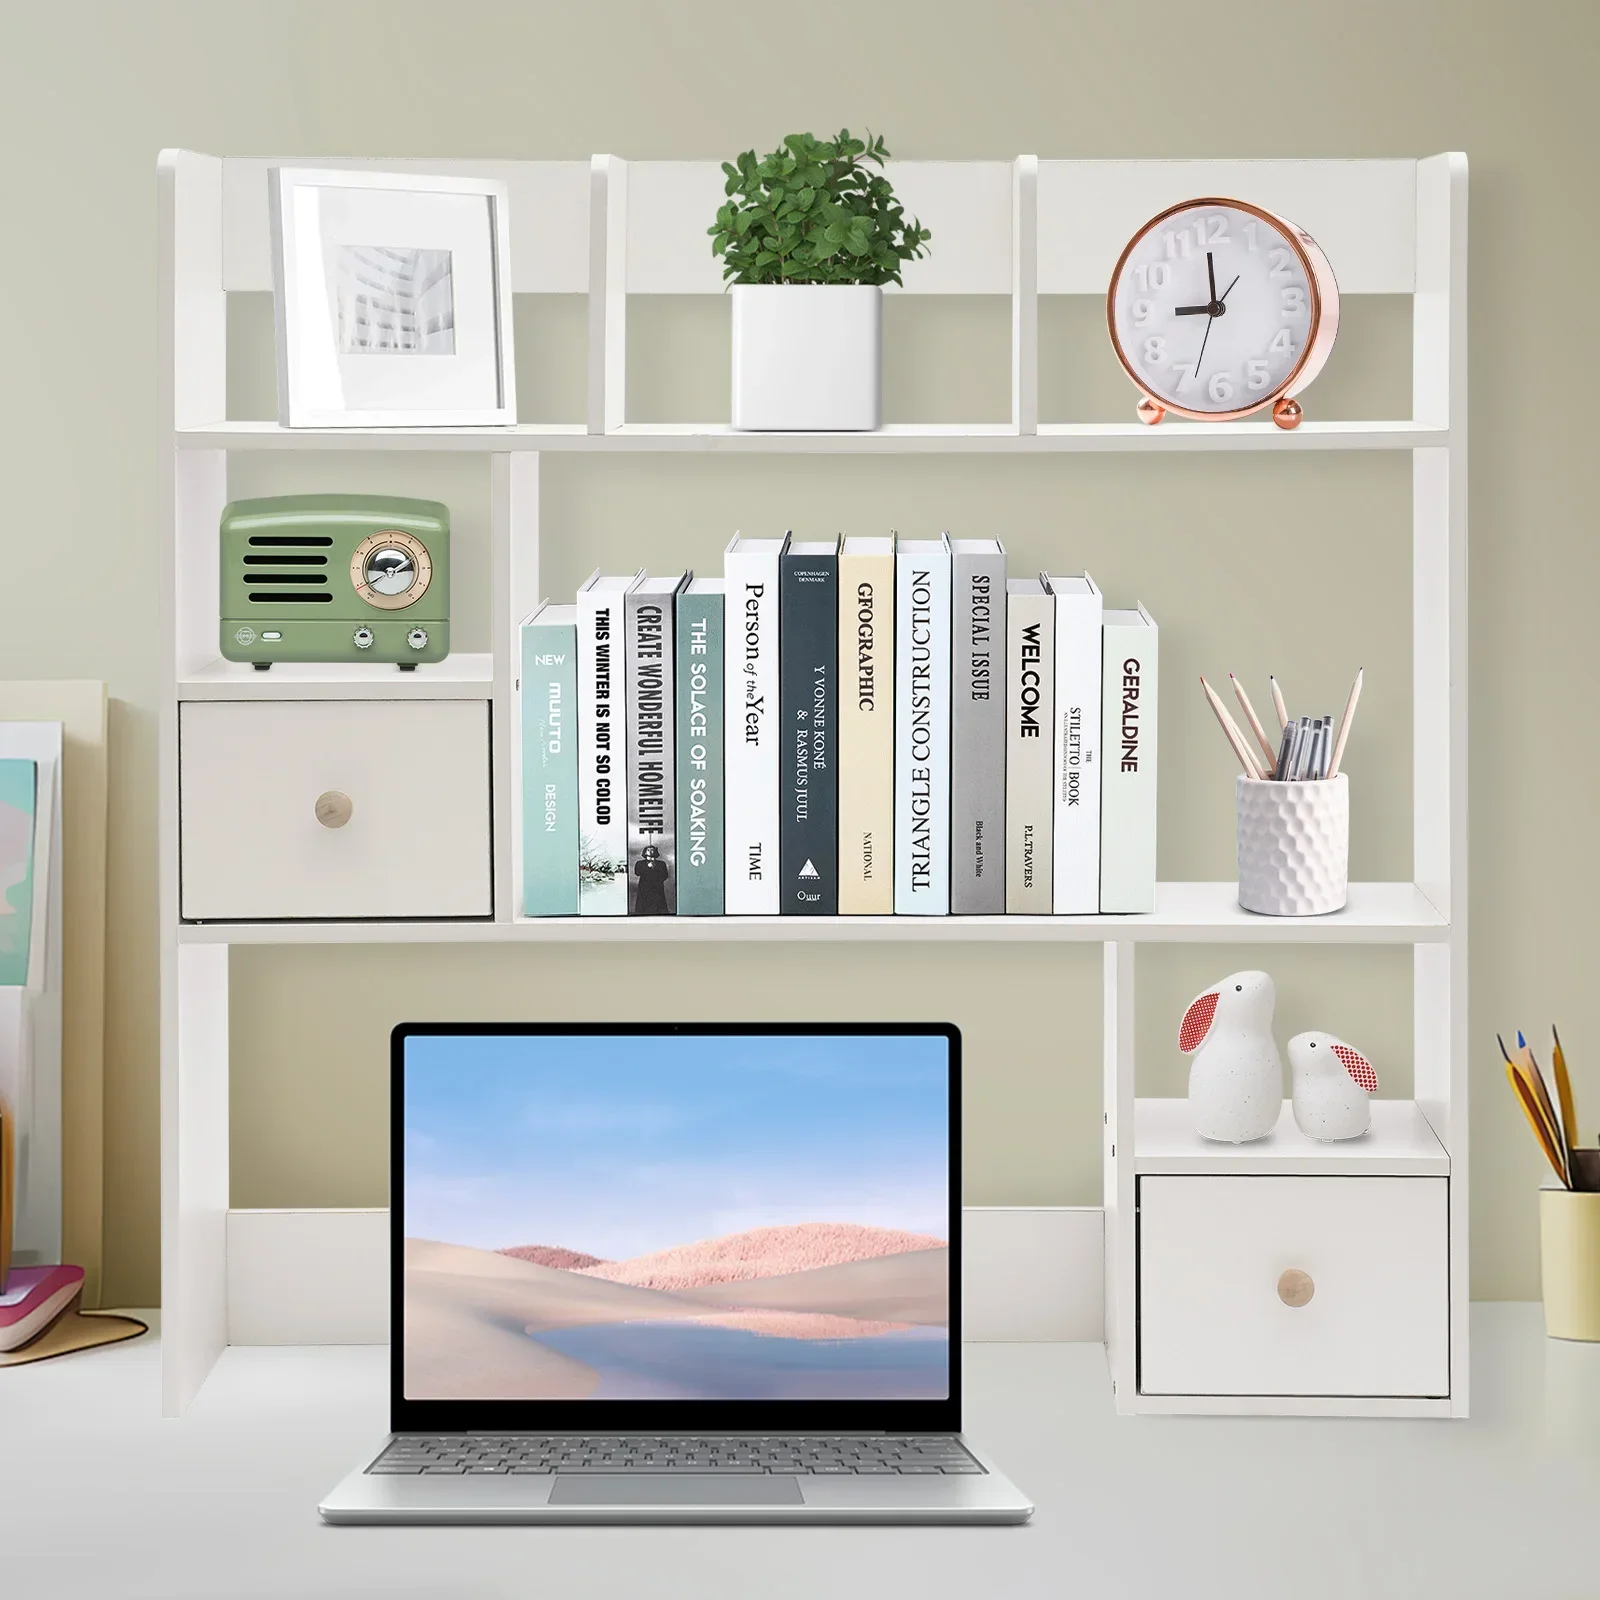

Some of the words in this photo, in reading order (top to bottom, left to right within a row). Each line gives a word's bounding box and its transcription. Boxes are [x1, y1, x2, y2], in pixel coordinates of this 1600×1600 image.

[1161, 229, 1190, 259] 11
[1193, 215, 1230, 246] 12
[1243, 222, 1257, 250] 1
[1134, 262, 1171, 291] 10
[1269, 248, 1292, 278] 2
[1133, 299, 1153, 327] 9
[1281, 287, 1306, 317] 3
[1144, 337, 1167, 364] 8
[1269, 328, 1295, 358] 4
[1172, 363, 1195, 392] 7
[1208, 371, 1233, 403] 6
[1247, 360, 1271, 391] 5
[596, 608, 609, 640] THIS
[746, 584, 763, 660] Person
[972, 576, 990, 645] SPECIAL
[637, 606, 662, 658] CREATE
[691, 618, 706, 654] THE
[858, 583, 874, 711] GFOGRAPHIC
[536, 655, 566, 665] NEW
[596, 644, 609, 699] WINTER
[745, 663, 757, 681] of
[912, 571, 930, 761] CONSTRUCTION
[972, 652, 989, 700] ISSUE
[747, 681, 756, 698] the
[1021, 623, 1040, 737] WELCOME
[596, 704, 610, 717] IS
[638, 664, 663, 755] WONDERFUL
[691, 663, 706, 736] SOLACE
[797, 710, 808, 720] &
[1121, 658, 1140, 772] GERALDINE
[548, 683, 561, 753] MUUTO
[746, 696, 764, 746] Year
[596, 723, 610, 750] NOT
[814, 730, 826, 770] KONÉ
[1069, 708, 1081, 765] STILETTO
[596, 755, 610, 774] SO
[691, 744, 706, 771] OF
[797, 729, 808, 785] RASMUS
[596, 779, 610, 825] COLOD
[638, 762, 663, 834] HOMELIFE
[795, 787, 808, 822] JUUL
[1069, 772, 1079, 806] BOOK
[544, 785, 556, 831] DESIGN
[690, 779, 706, 867] SOAKING
[912, 768, 930, 892] TRIANGLE
[975, 820, 984, 841] Black
[749, 843, 761, 880] TIME
[864, 833, 872, 881] NATIONAL
[975, 842, 984, 855] and
[975, 856, 984, 877] White
